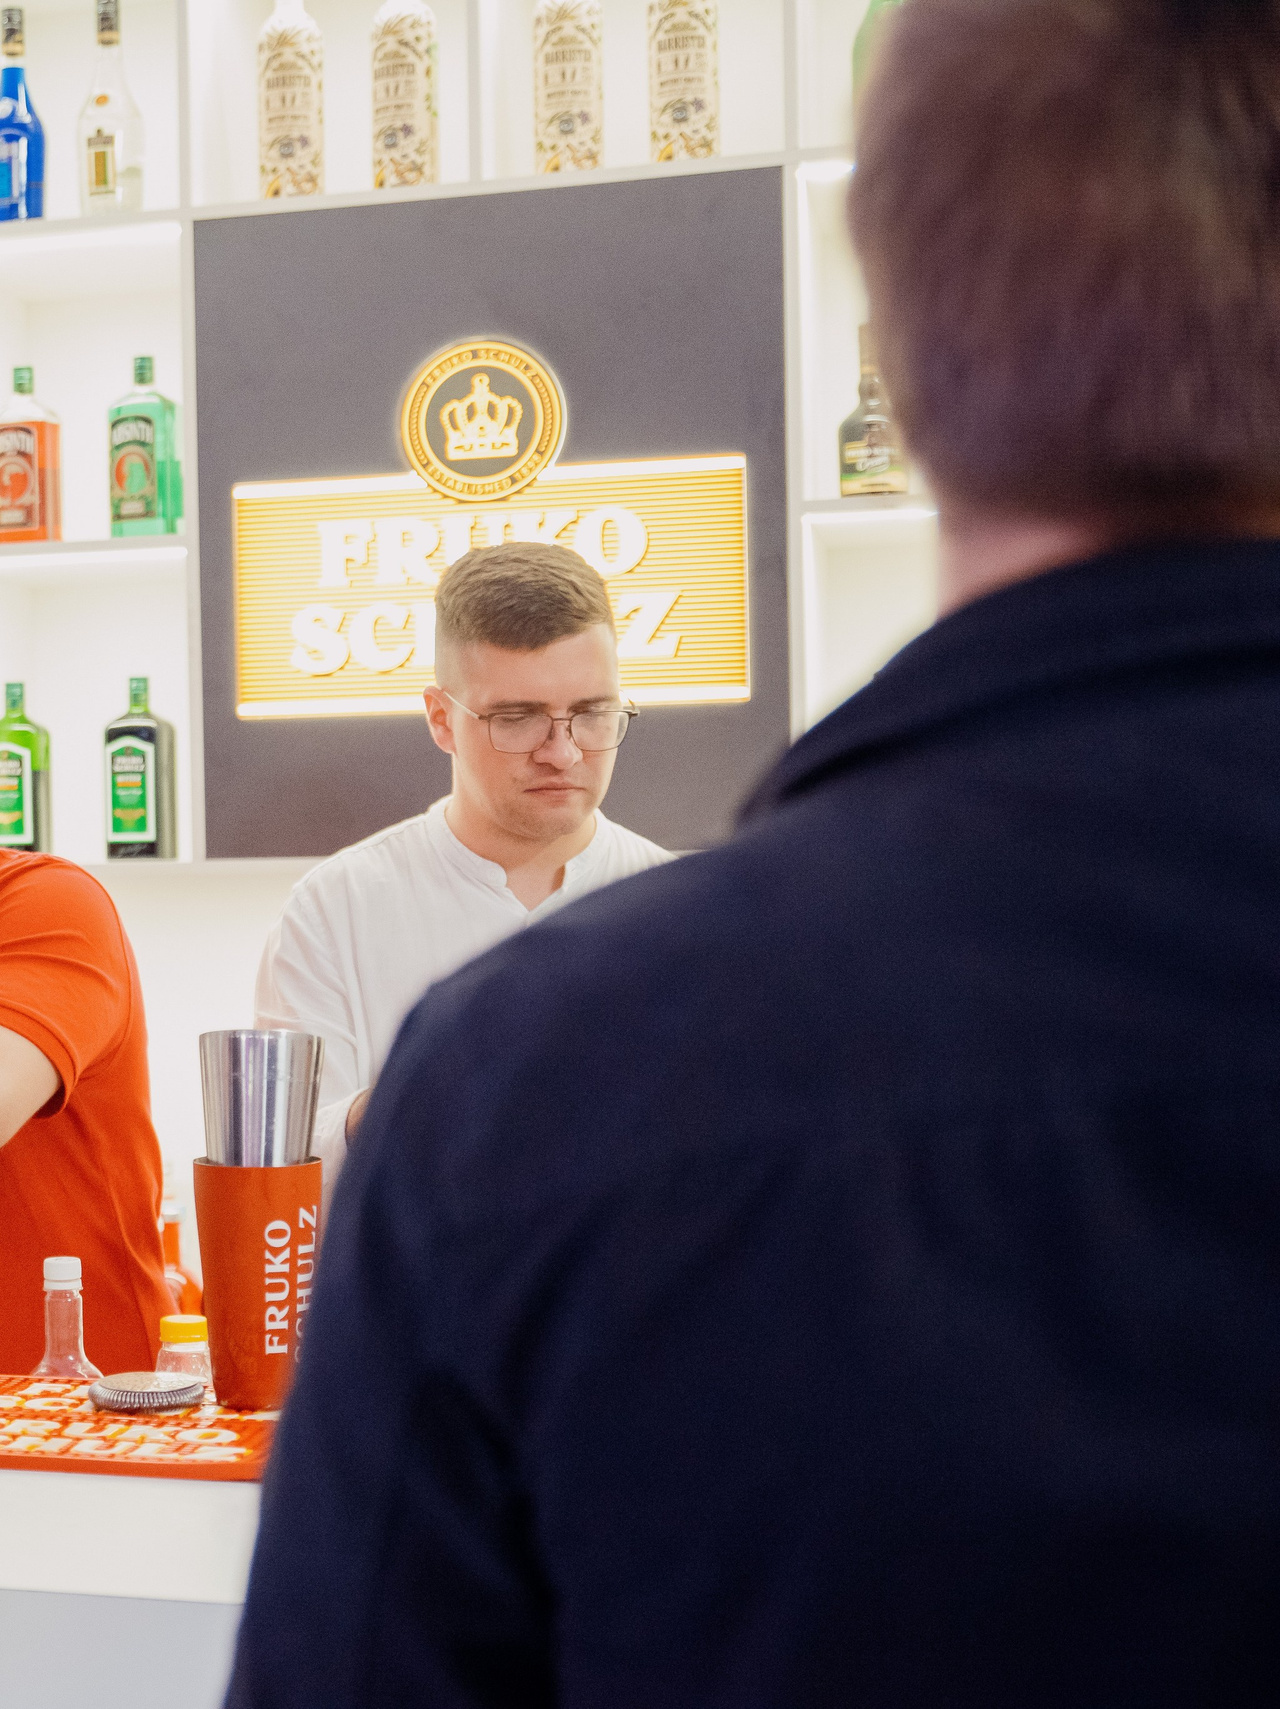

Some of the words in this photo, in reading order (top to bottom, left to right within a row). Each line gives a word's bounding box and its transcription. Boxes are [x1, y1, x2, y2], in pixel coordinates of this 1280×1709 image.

[477, 349, 538, 378] SCHULZ
[427, 463, 512, 495] ESTABLISHED
[288, 590, 683, 676] SCZ
[264, 1220, 291, 1355] FRUKO
